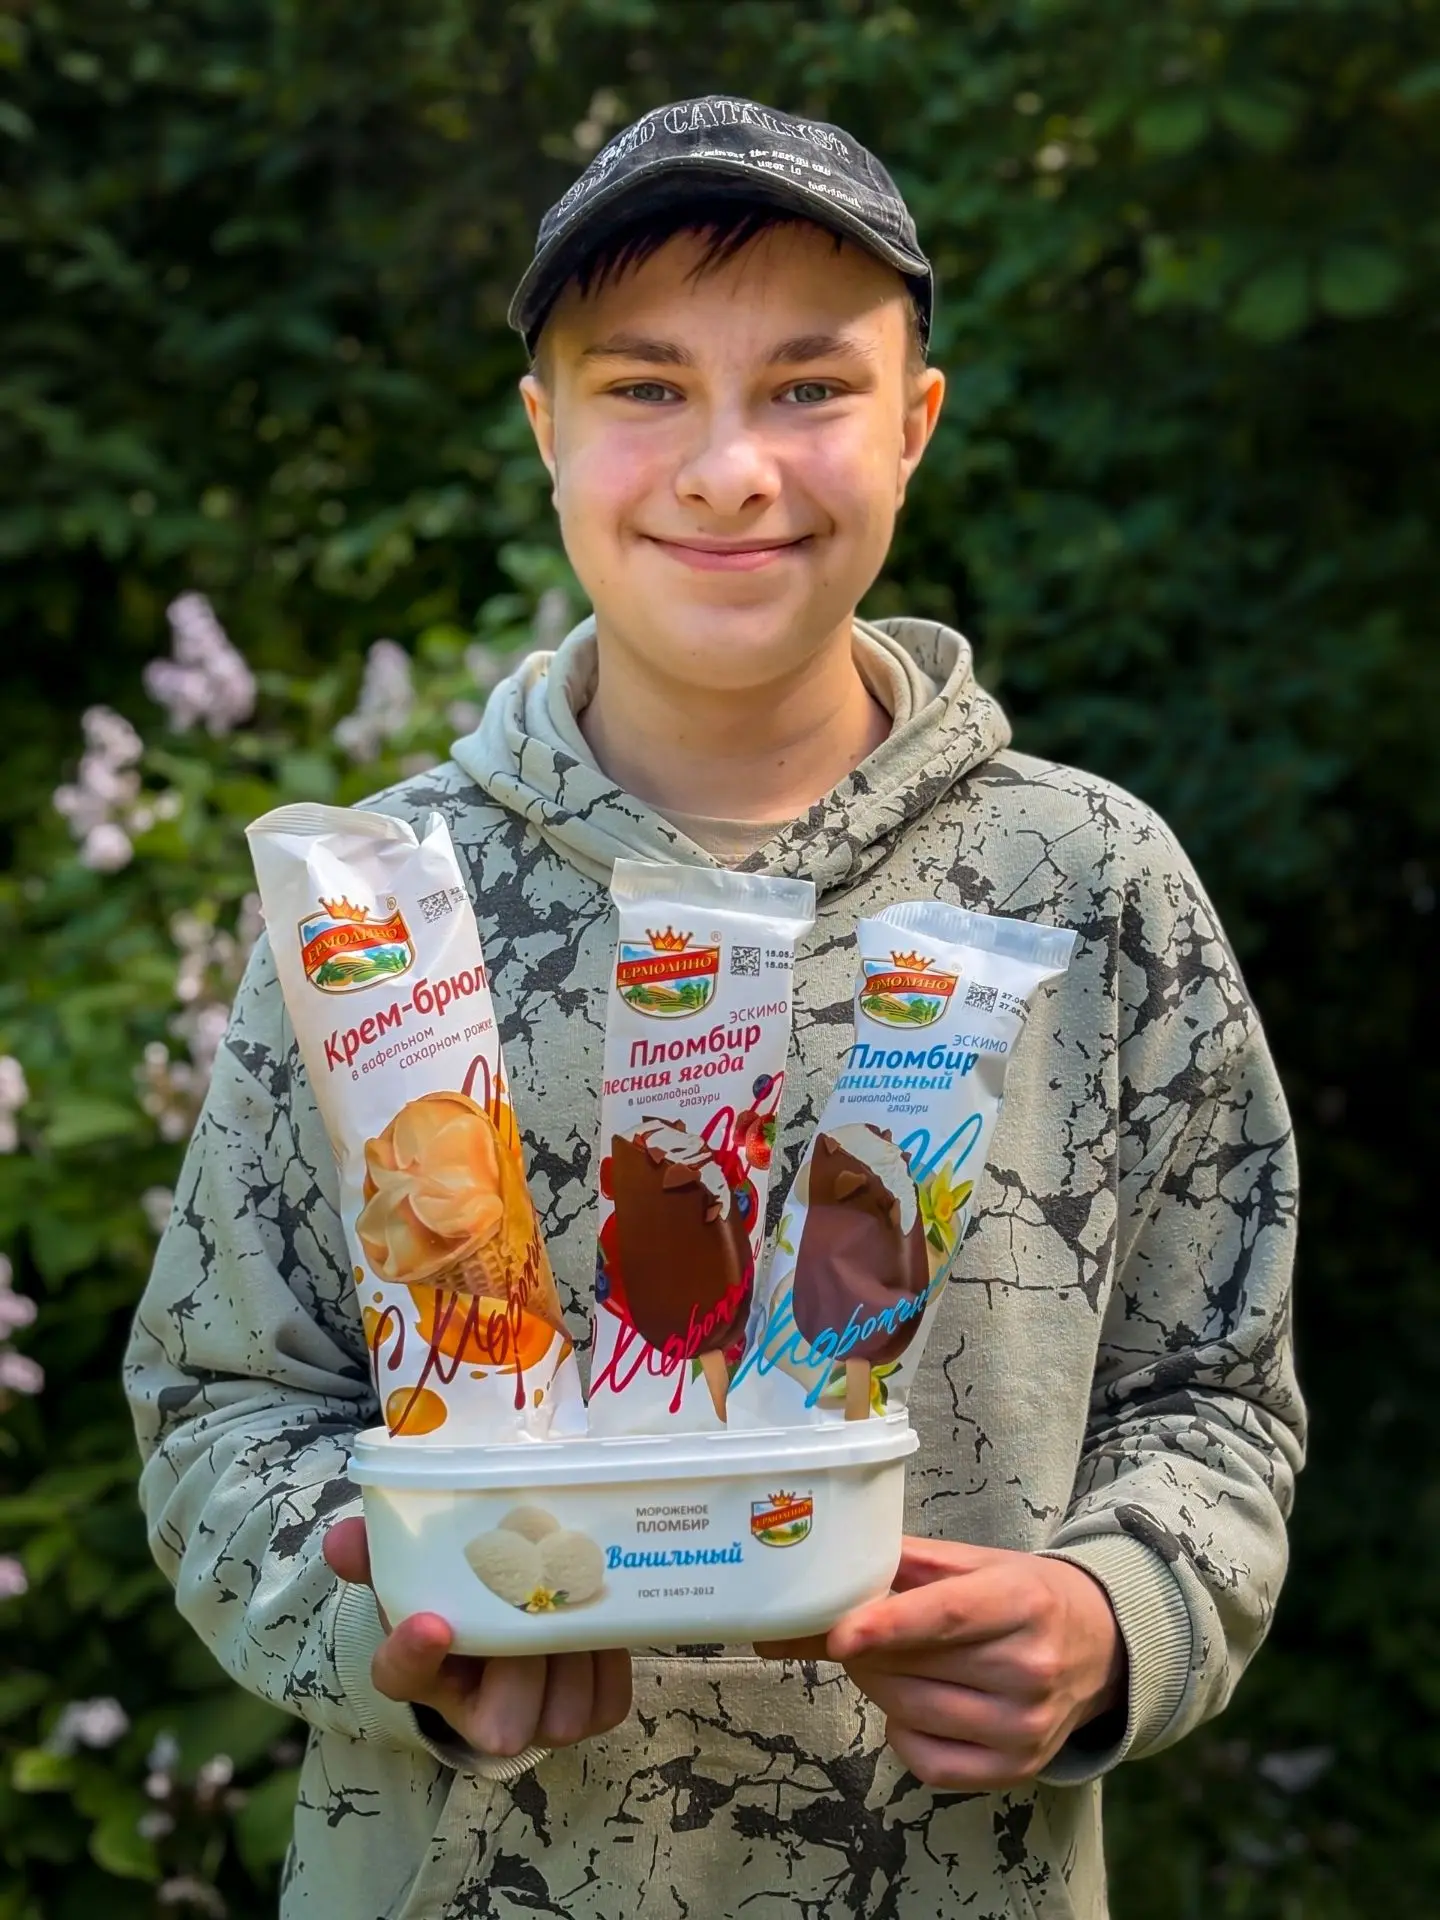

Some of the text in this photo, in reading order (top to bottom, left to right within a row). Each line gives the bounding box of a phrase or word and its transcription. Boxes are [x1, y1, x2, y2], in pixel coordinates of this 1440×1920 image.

[307, 926, 398, 964] ЕРМОЛИНО
[622, 957, 712, 979] ЕРМОЛИНО
[322, 964, 487, 1072] Крем-брюл
[729, 1001, 788, 1025] ЭСКИМО
[351, 1026, 435, 1082] в вафельном
[399, 1032, 461, 1070] сахарном
[630, 1024, 761, 1068] Пломбир
[952, 1035, 1008, 1054] ЭСКИМО
[679, 1053, 744, 1083] ягода
[847, 1043, 980, 1077] Пломбир
[835, 1071, 953, 1090] анильный
[636, 1084, 700, 1105] шоколадной
[679, 1092, 720, 1108] глазури
[847, 1092, 911, 1103] шоколадной
[887, 1104, 929, 1115] глазури
[636, 1505, 709, 1517] МОРОЖЕНОЕ
[636, 1518, 710, 1533] ПЛОМБИР
[605, 1541, 744, 1570] Ванильный
[638, 1589, 660, 1598] ГОСТ
